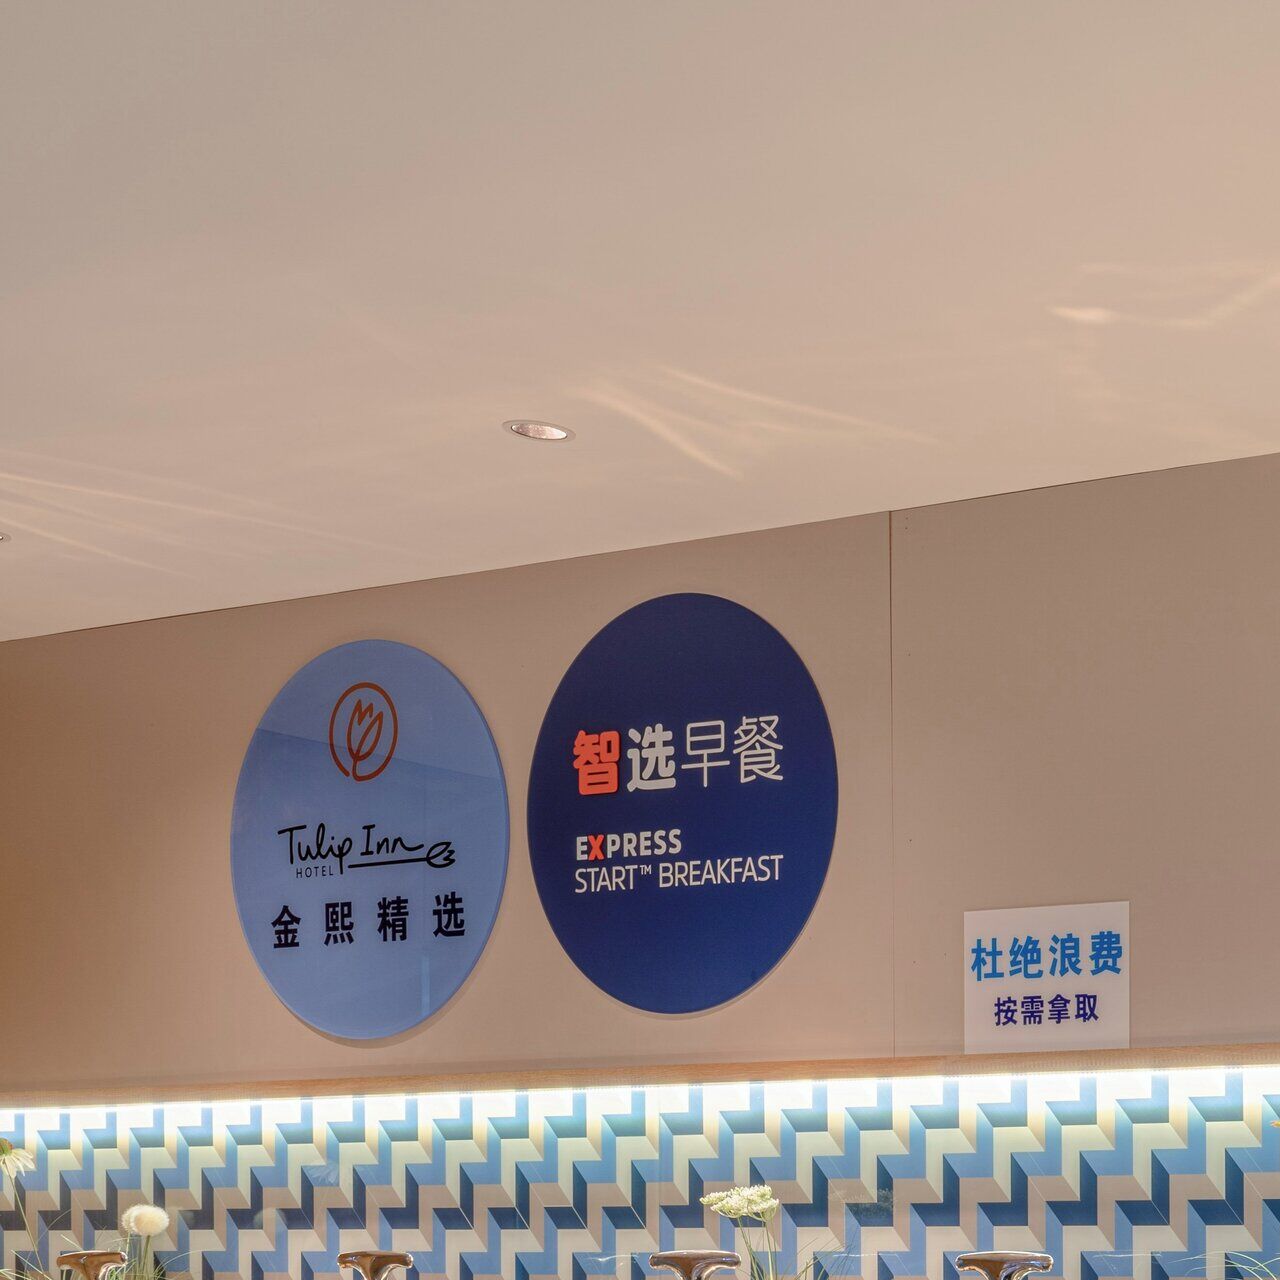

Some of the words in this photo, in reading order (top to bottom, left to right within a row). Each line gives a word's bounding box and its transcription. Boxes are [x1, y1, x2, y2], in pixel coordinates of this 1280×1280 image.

[573, 715, 784, 796] 智选早餐
[277, 822, 353, 875] Tulip
[360, 824, 425, 856] Inn
[575, 828, 682, 861] EXPRESS
[295, 865, 334, 879] HOTEL
[658, 854, 784, 888] BREAKFAST
[271, 891, 466, 949] 金熙精选
[971, 930, 1123, 982] 杜绝浪费
[994, 993, 1099, 1026] 按需拿取
